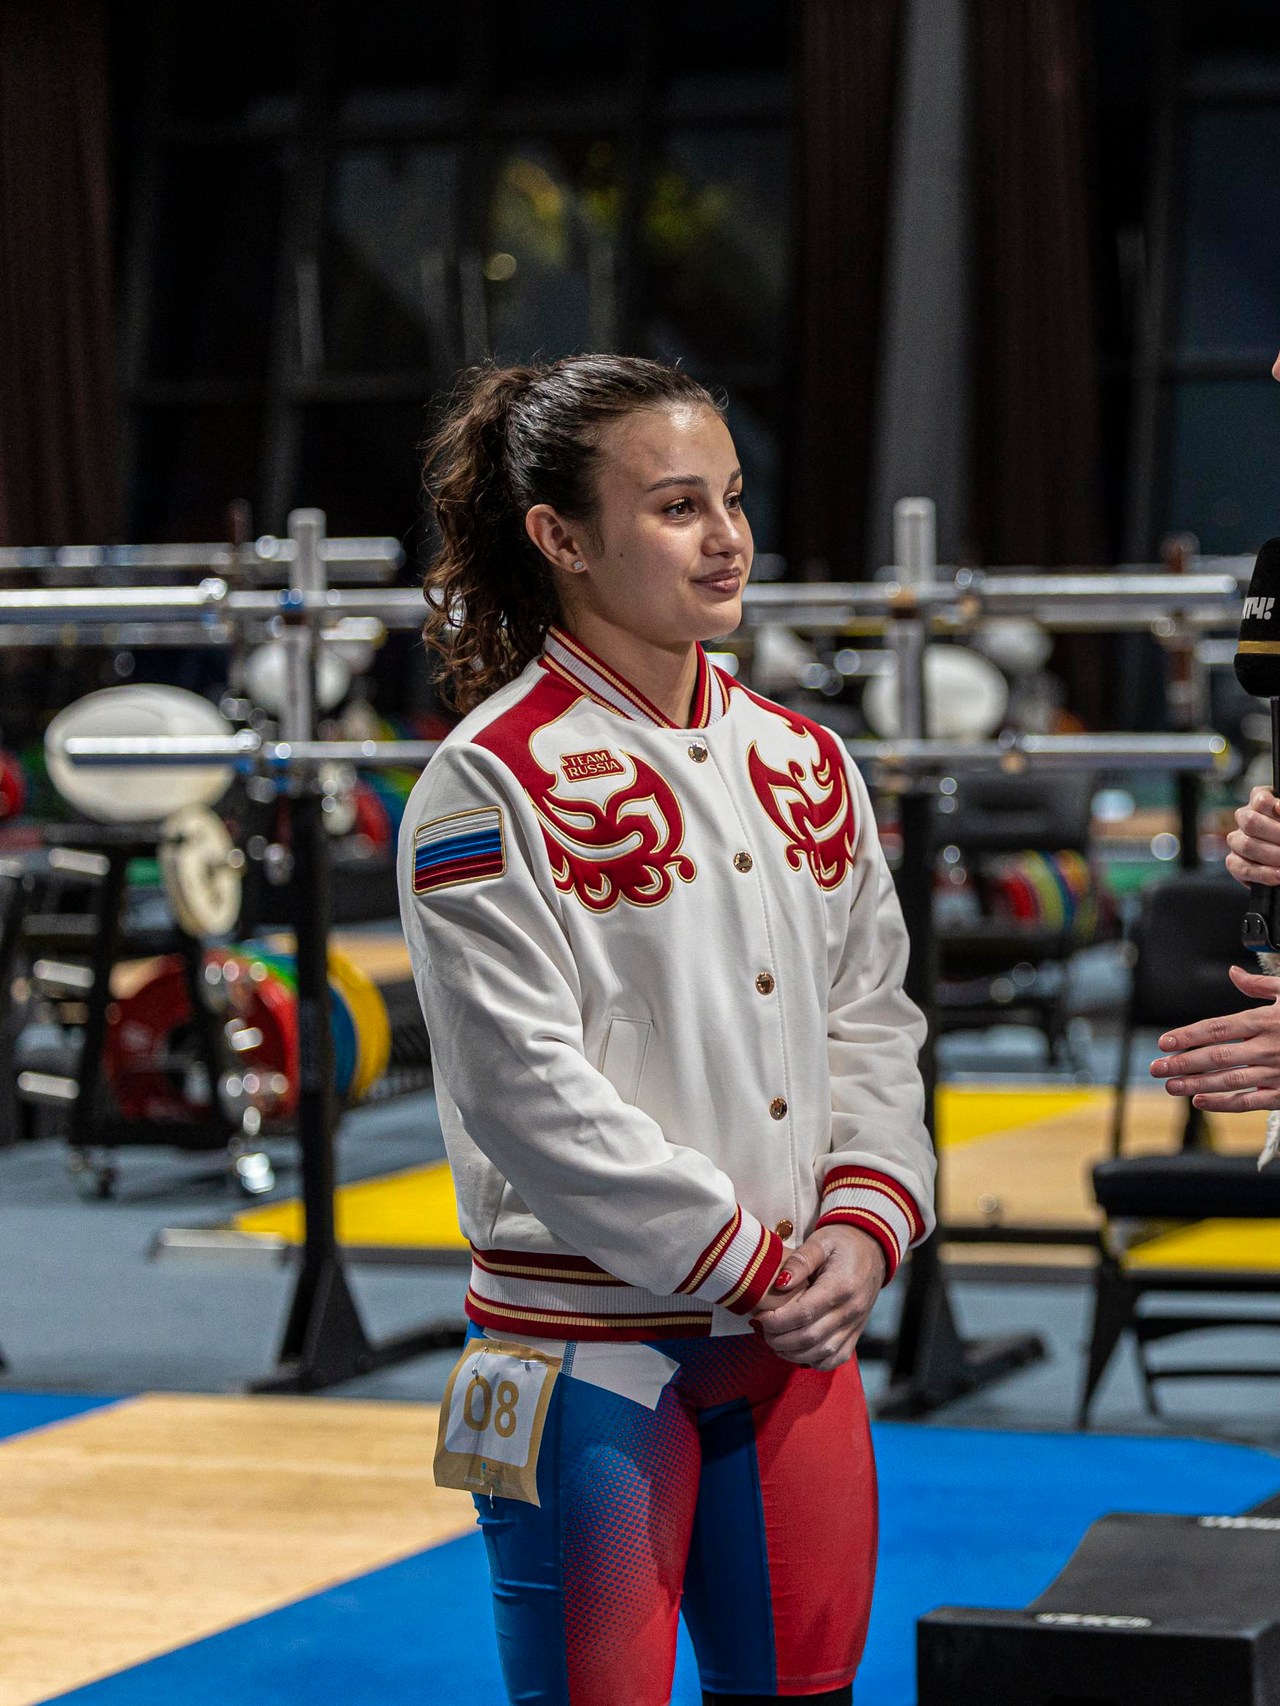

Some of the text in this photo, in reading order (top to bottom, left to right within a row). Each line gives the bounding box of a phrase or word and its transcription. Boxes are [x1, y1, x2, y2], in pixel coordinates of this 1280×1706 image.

[568, 752, 609, 767] TEAM
[567, 760, 620, 777] RUSSIA
[463, 1375, 520, 1438] 08
